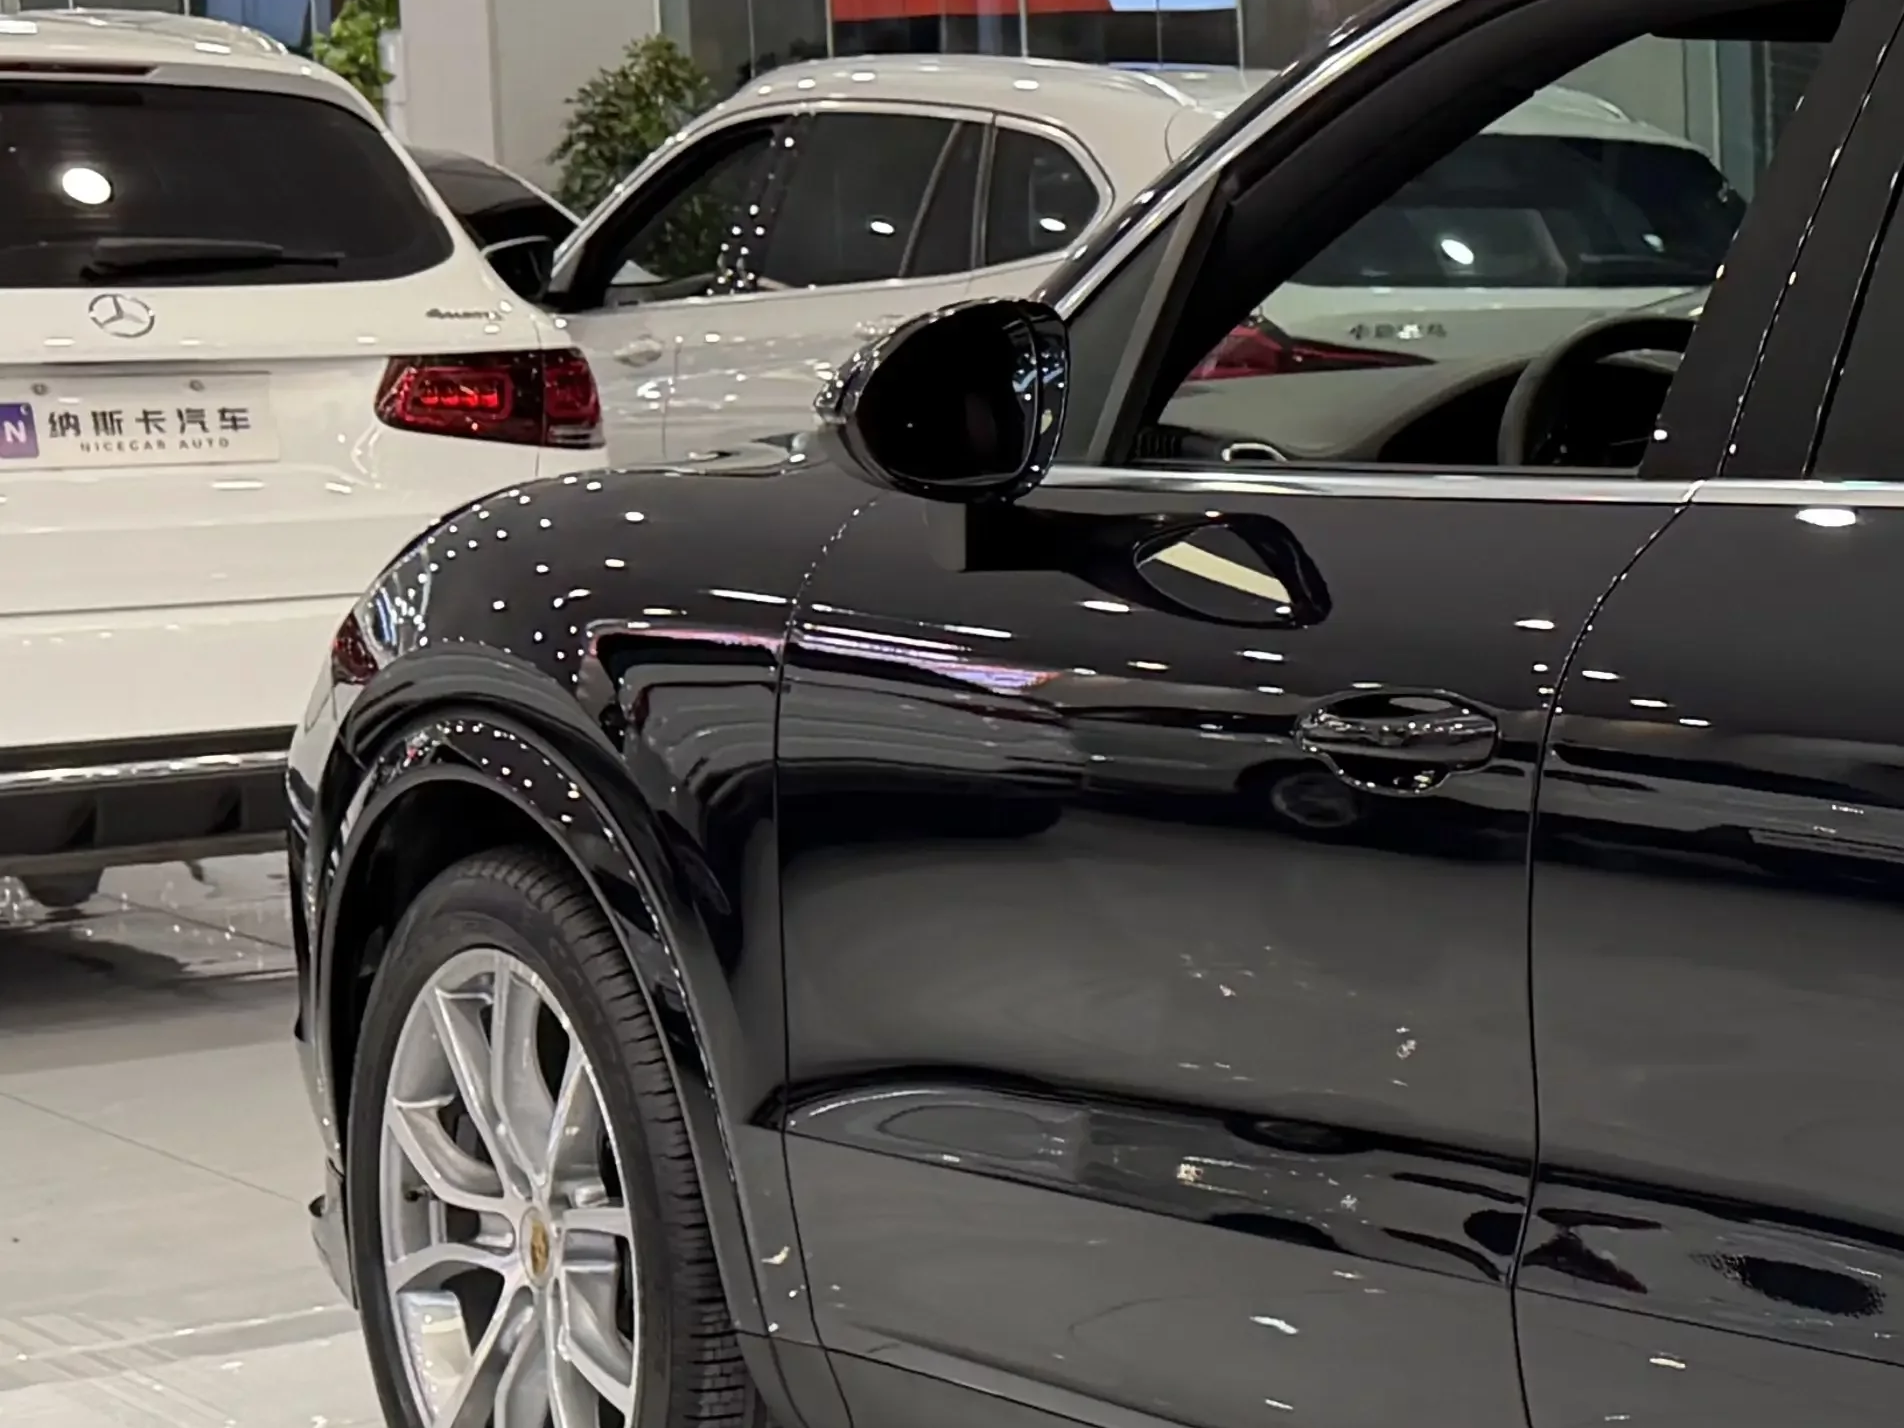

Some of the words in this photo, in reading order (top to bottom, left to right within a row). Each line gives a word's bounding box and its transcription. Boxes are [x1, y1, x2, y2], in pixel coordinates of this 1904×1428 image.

[3, 420, 28, 444] N
[48, 407, 251, 438] 纳斯卡汽车
[179, 438, 230, 450] AUTO
